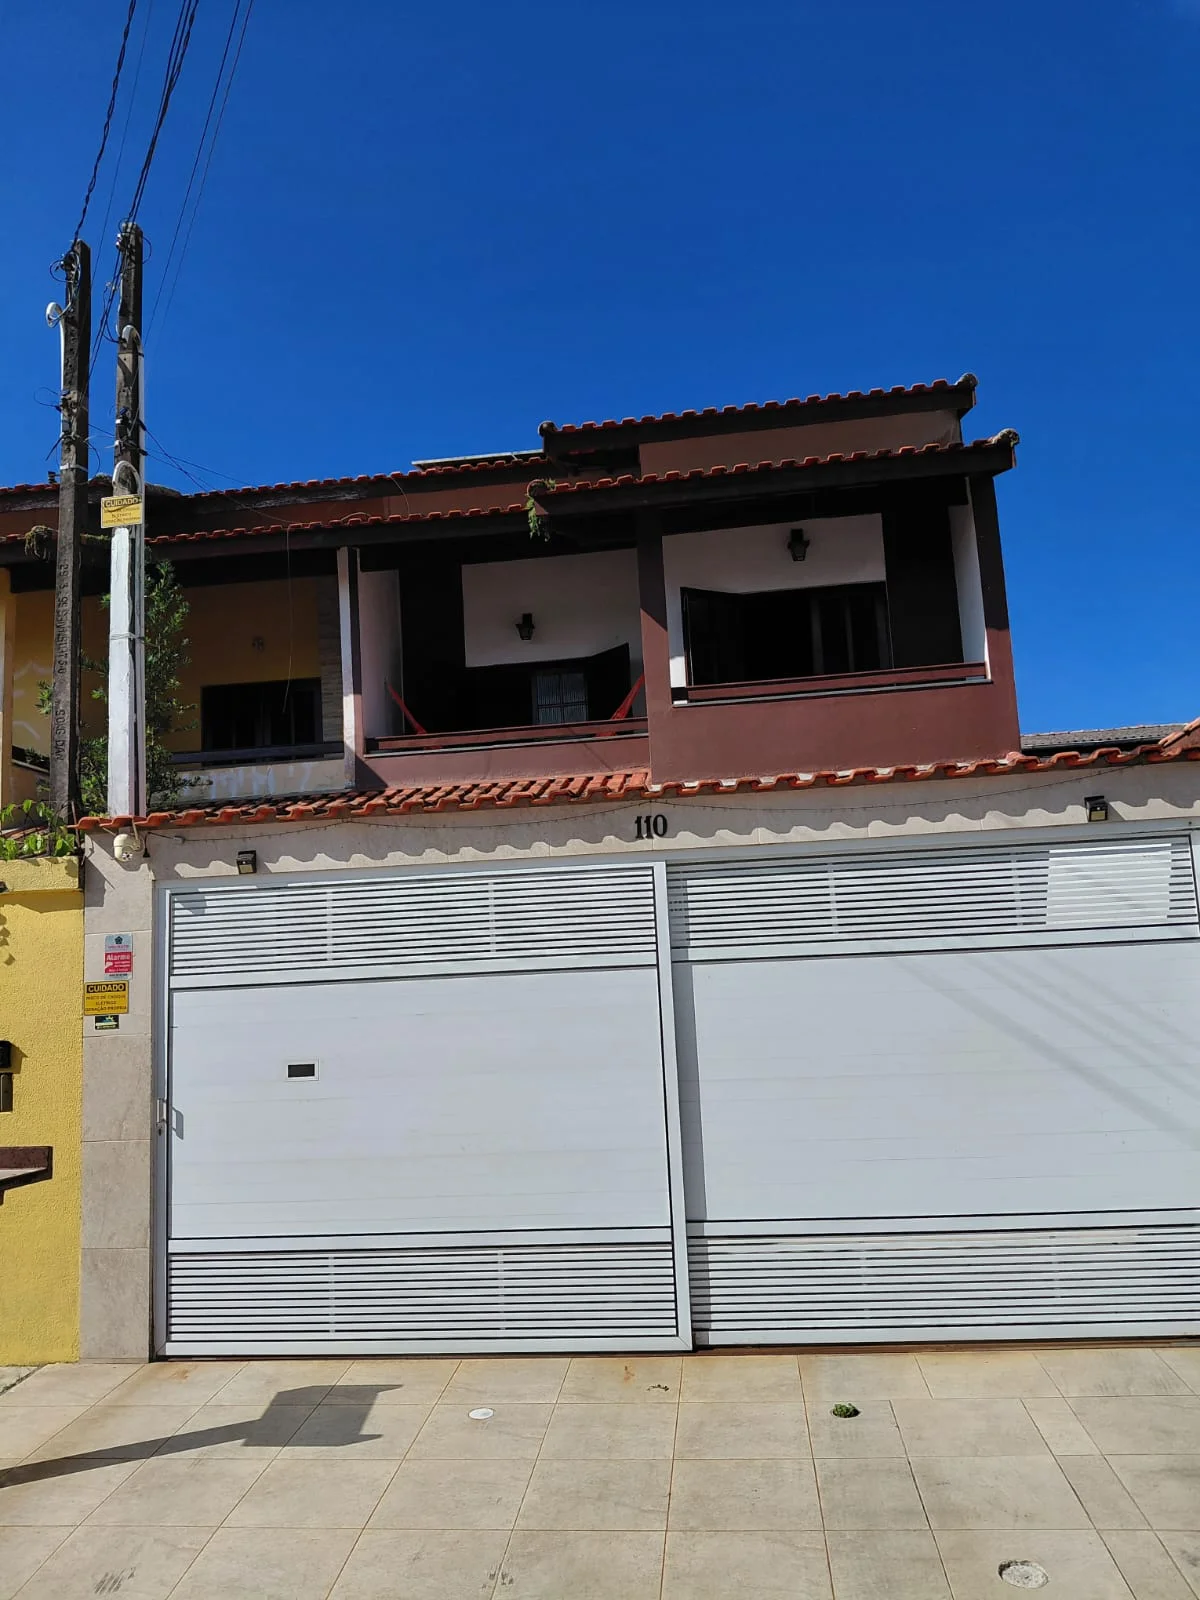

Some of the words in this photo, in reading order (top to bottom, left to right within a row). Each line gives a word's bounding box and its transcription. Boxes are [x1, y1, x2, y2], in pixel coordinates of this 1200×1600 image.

[105, 497, 139, 507] CUIDADO
[634, 814, 668, 839] 110
[88, 983, 125, 993] CUIDADO
